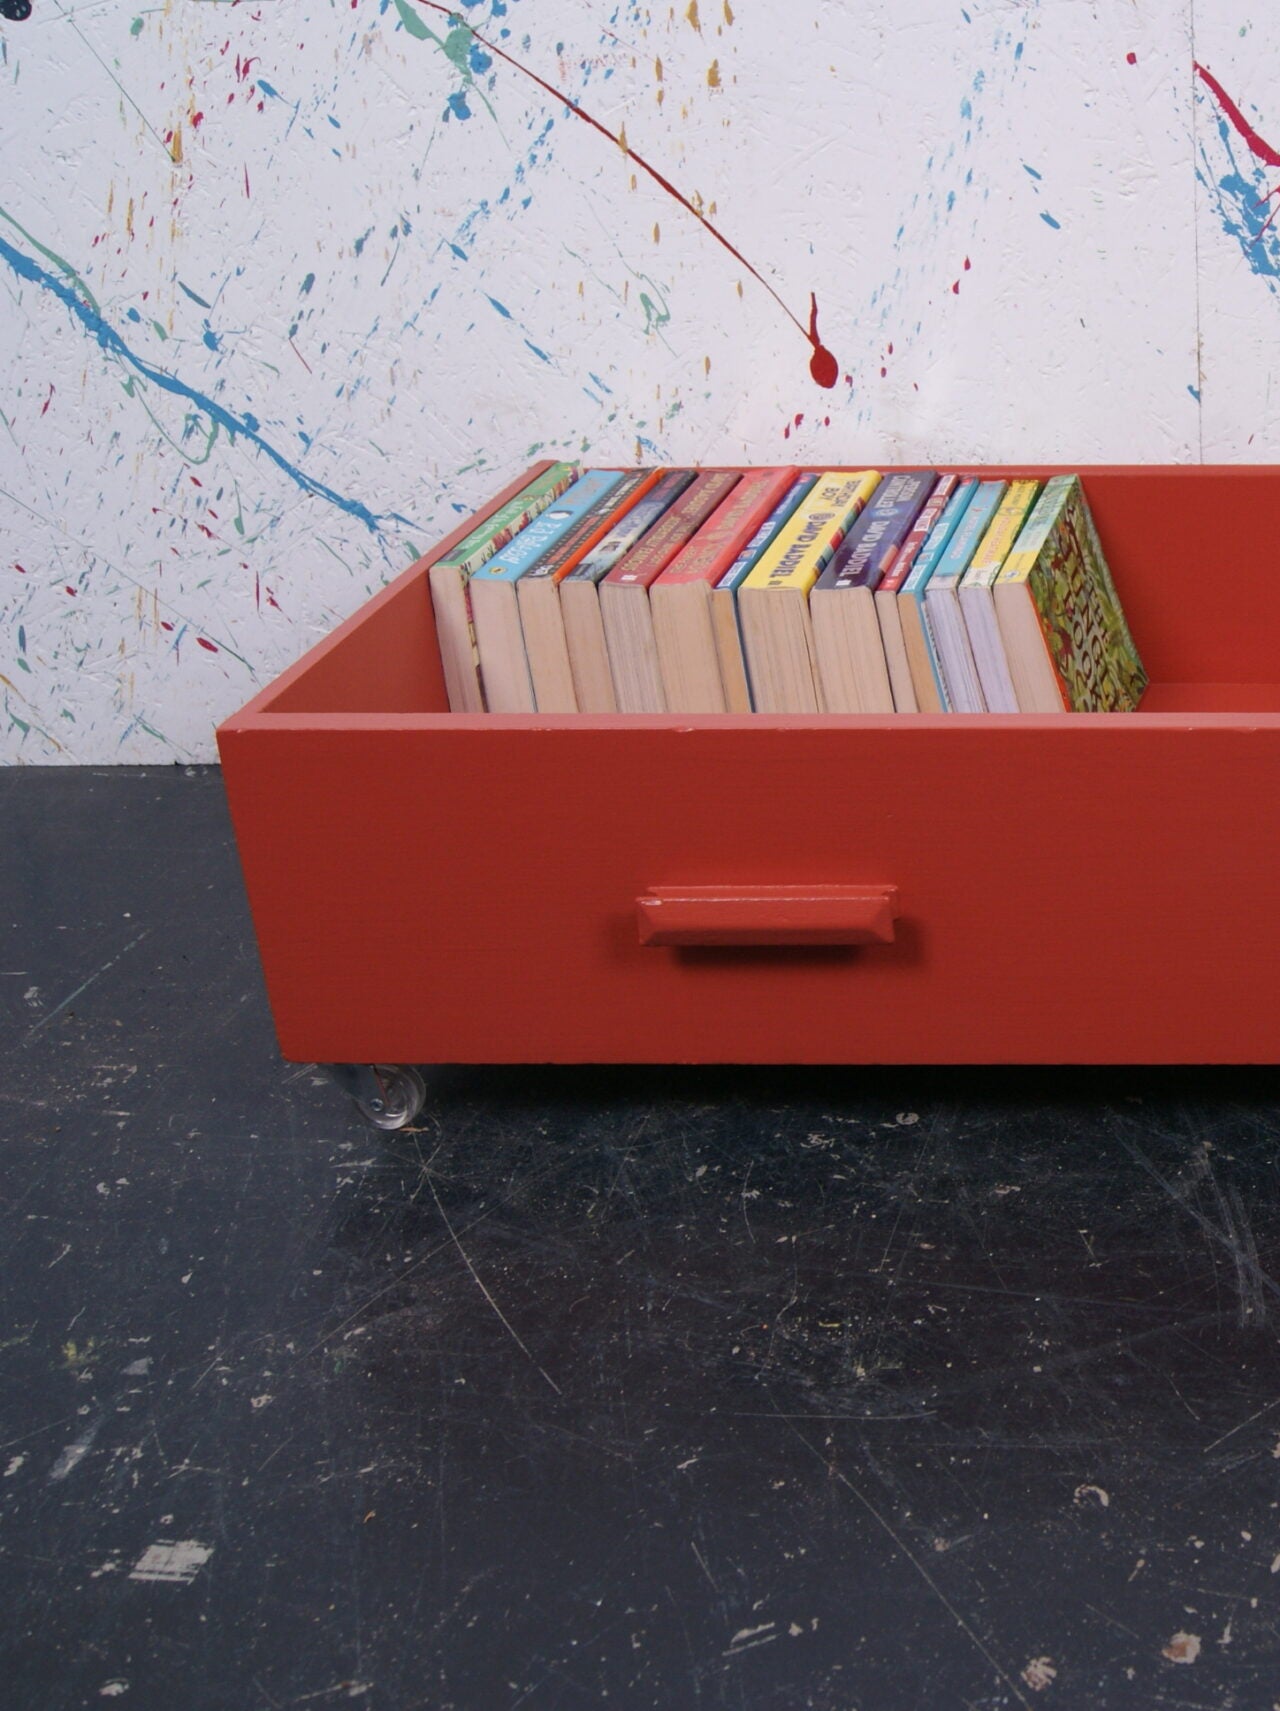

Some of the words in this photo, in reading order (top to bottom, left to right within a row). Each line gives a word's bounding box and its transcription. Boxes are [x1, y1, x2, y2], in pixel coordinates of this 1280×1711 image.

[818, 487, 840, 500] BOY
[794, 520, 826, 543] DAVID
[859, 520, 891, 541] DAVID
[768, 542, 810, 580] BADDIEL
[838, 542, 877, 576] BADDIEL
[1063, 595, 1102, 712] BOOK
